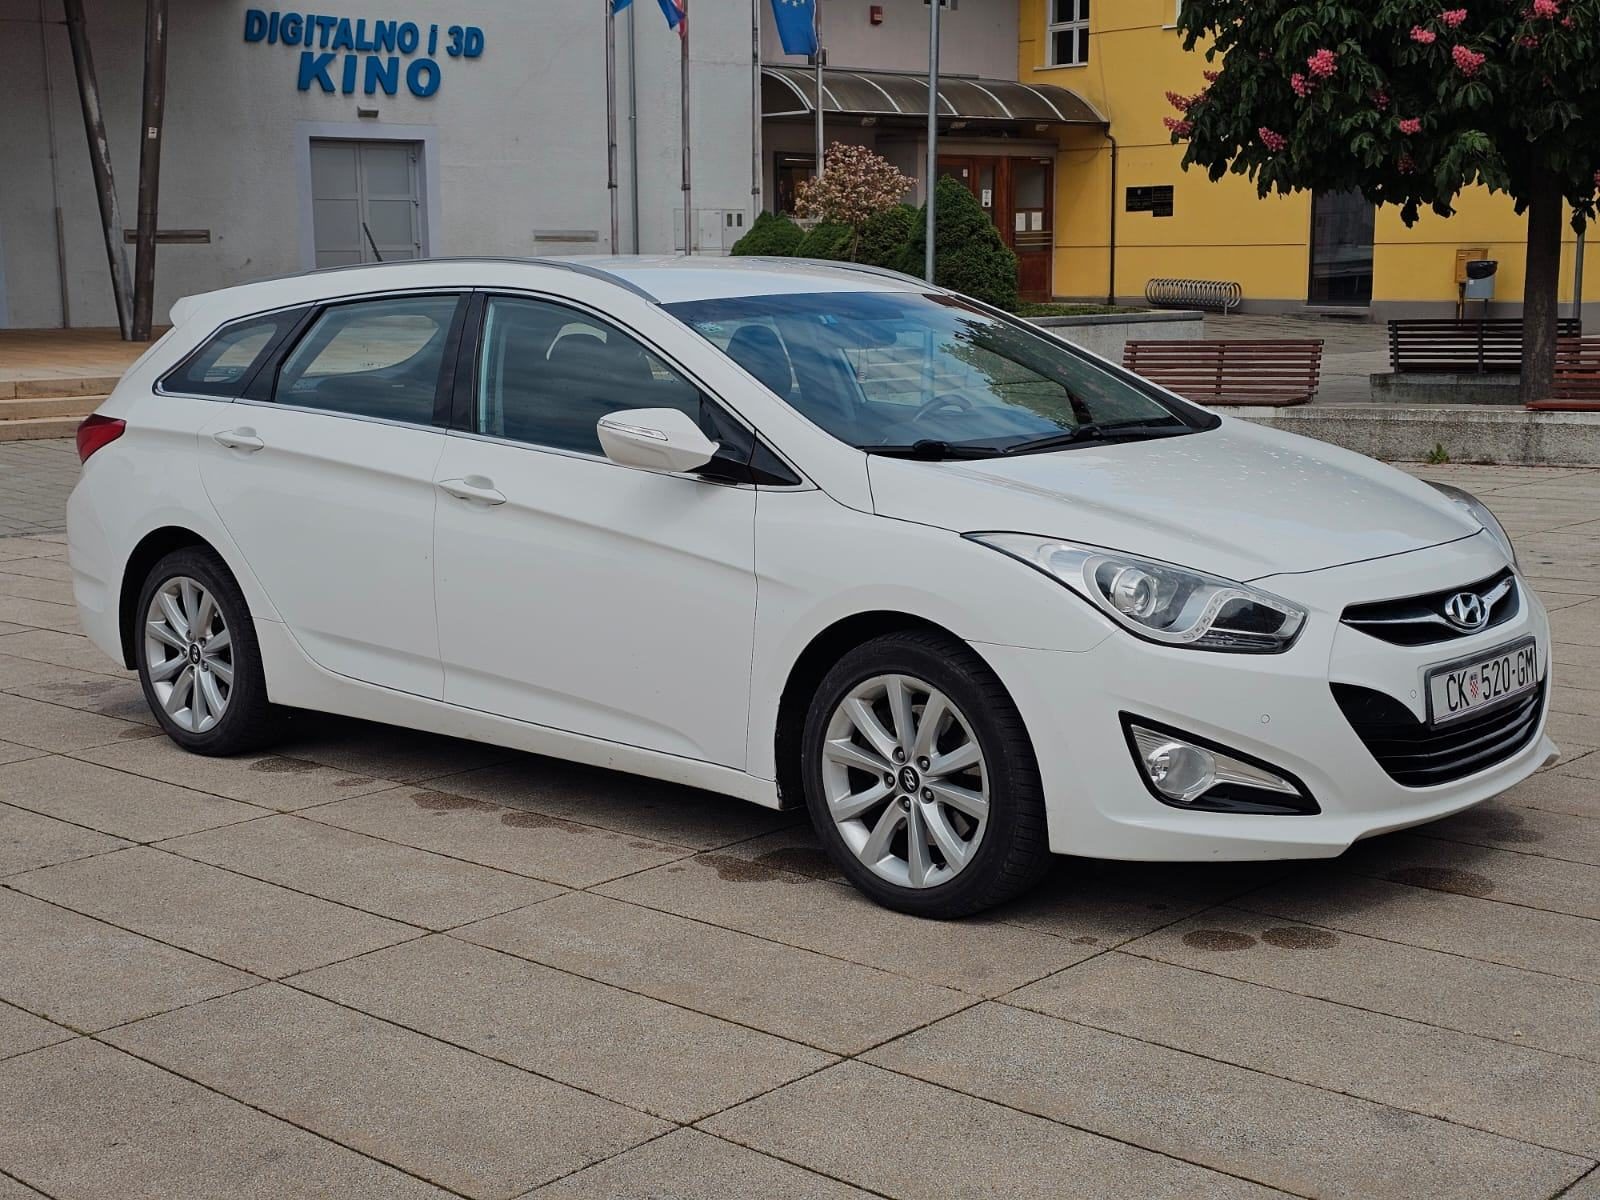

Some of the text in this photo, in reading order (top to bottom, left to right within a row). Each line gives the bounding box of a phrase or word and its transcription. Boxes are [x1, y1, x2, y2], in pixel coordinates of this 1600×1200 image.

[244, 9, 419, 54] DIGITALNO
[446, 25, 485, 58] 3D
[297, 51, 441, 97] KINO
[1481, 648, 1535, 700] 520-GM
